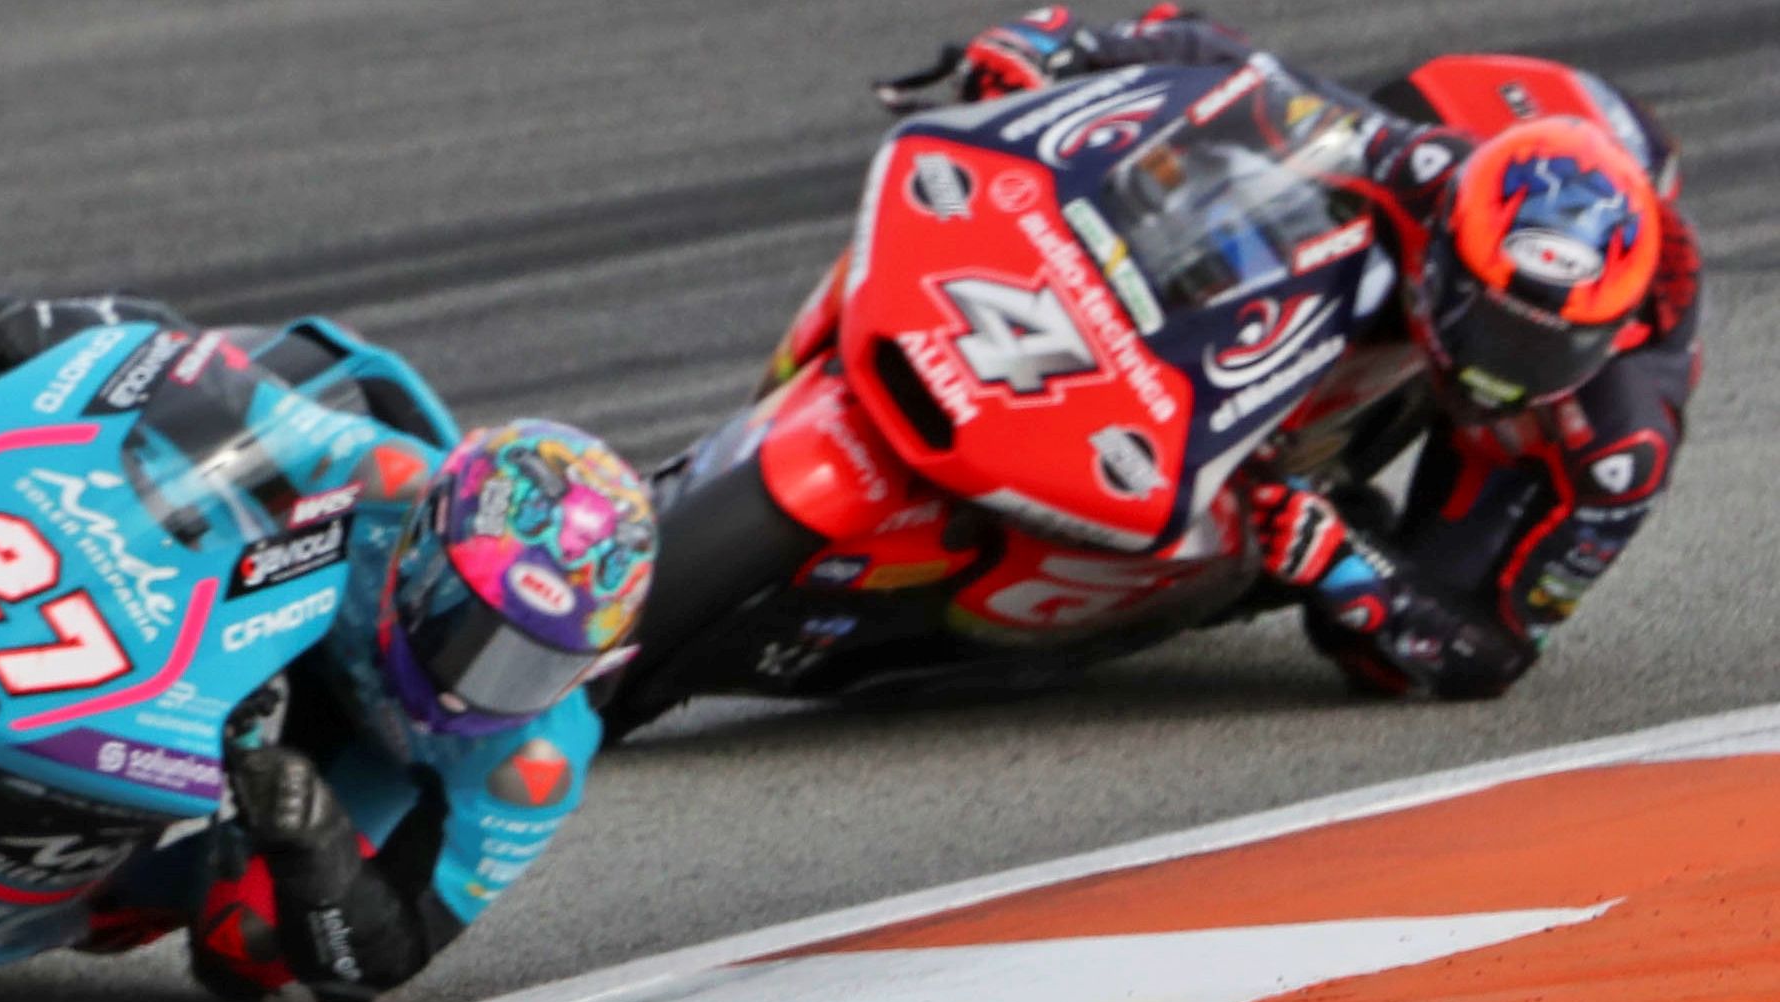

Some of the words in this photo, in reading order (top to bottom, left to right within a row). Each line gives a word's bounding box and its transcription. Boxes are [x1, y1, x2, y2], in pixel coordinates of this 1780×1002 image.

[939, 278, 1098, 394] 4
[1019, 212, 1179, 423] audio-technica
[33, 330, 125, 413] CFMOTO
[896, 332, 981, 426] ALIUM
[77, 537, 158, 643] HISPANIA
[222, 587, 338, 653] CFMOTO
